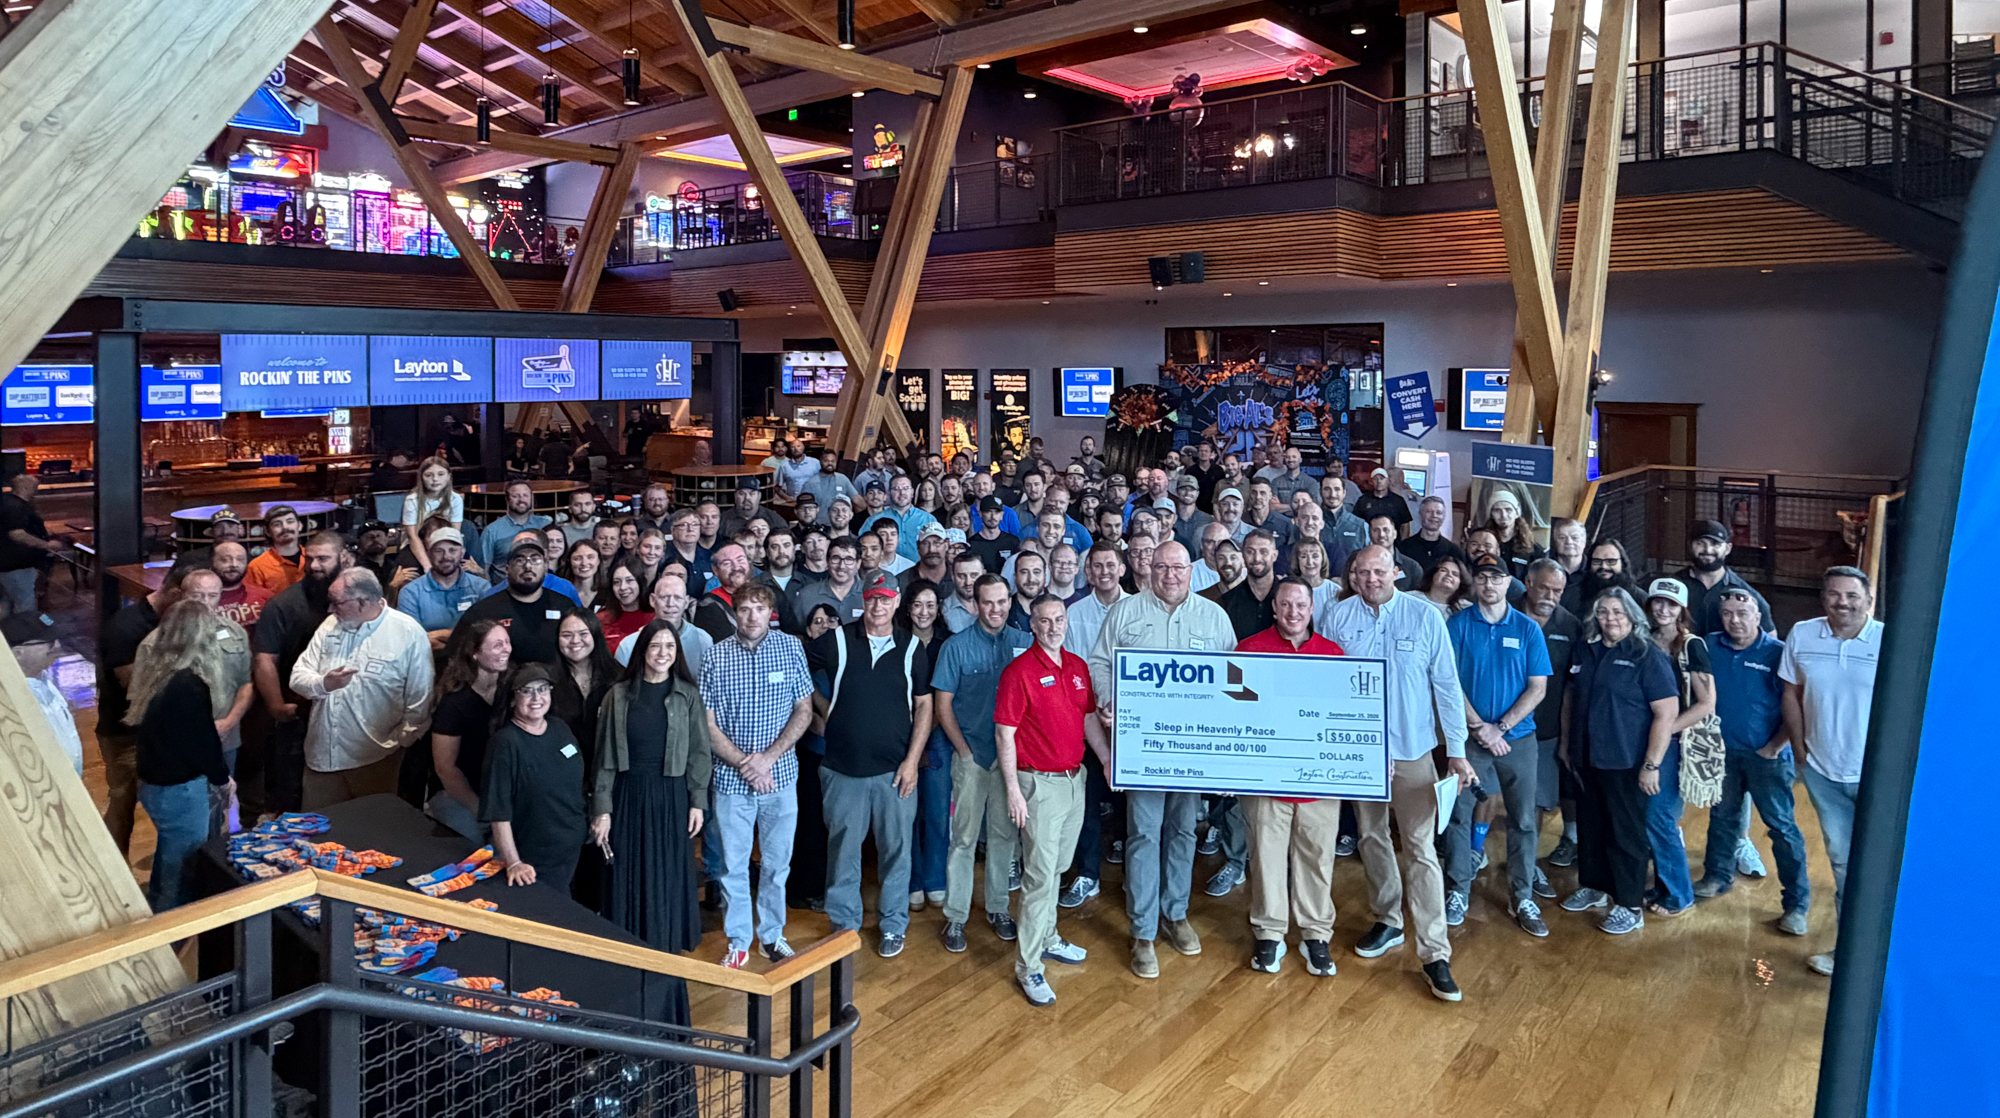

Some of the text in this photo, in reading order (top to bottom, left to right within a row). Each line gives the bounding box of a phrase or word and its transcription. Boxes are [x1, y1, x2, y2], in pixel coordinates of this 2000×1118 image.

[267, 356, 328, 367] welcome to
[394, 359, 448, 377] Layton
[240, 370, 352, 386] ROCKIN' THE PINS
[552, 373, 571, 383] PINS
[902, 376, 923, 386] Let's
[907, 385, 923, 395] get
[1391, 386, 1427, 399] CONVERT
[899, 393, 927, 403] Social!
[950, 390, 970, 401] BIG!
[1400, 395, 1421, 404] CASH
[1401, 401, 1422, 410] HERE
[1120, 655, 1214, 689] Layton
[1119, 690, 1166, 698] CONSTRUCTING
[1298, 709, 1320, 718] Date
[1154, 721, 1276, 736] Sleep in Heavenly Peace
[1316, 731, 1377, 744] $ $50,000
[1143, 739, 1267, 753] Fifty Thousand and 00/100
[1319, 752, 1364, 762] DOLLARS
[1144, 766, 1172, 775] Rockin'
[1187, 768, 1204, 776] Pins
[1293, 767, 1373, 781] Layton Construction
